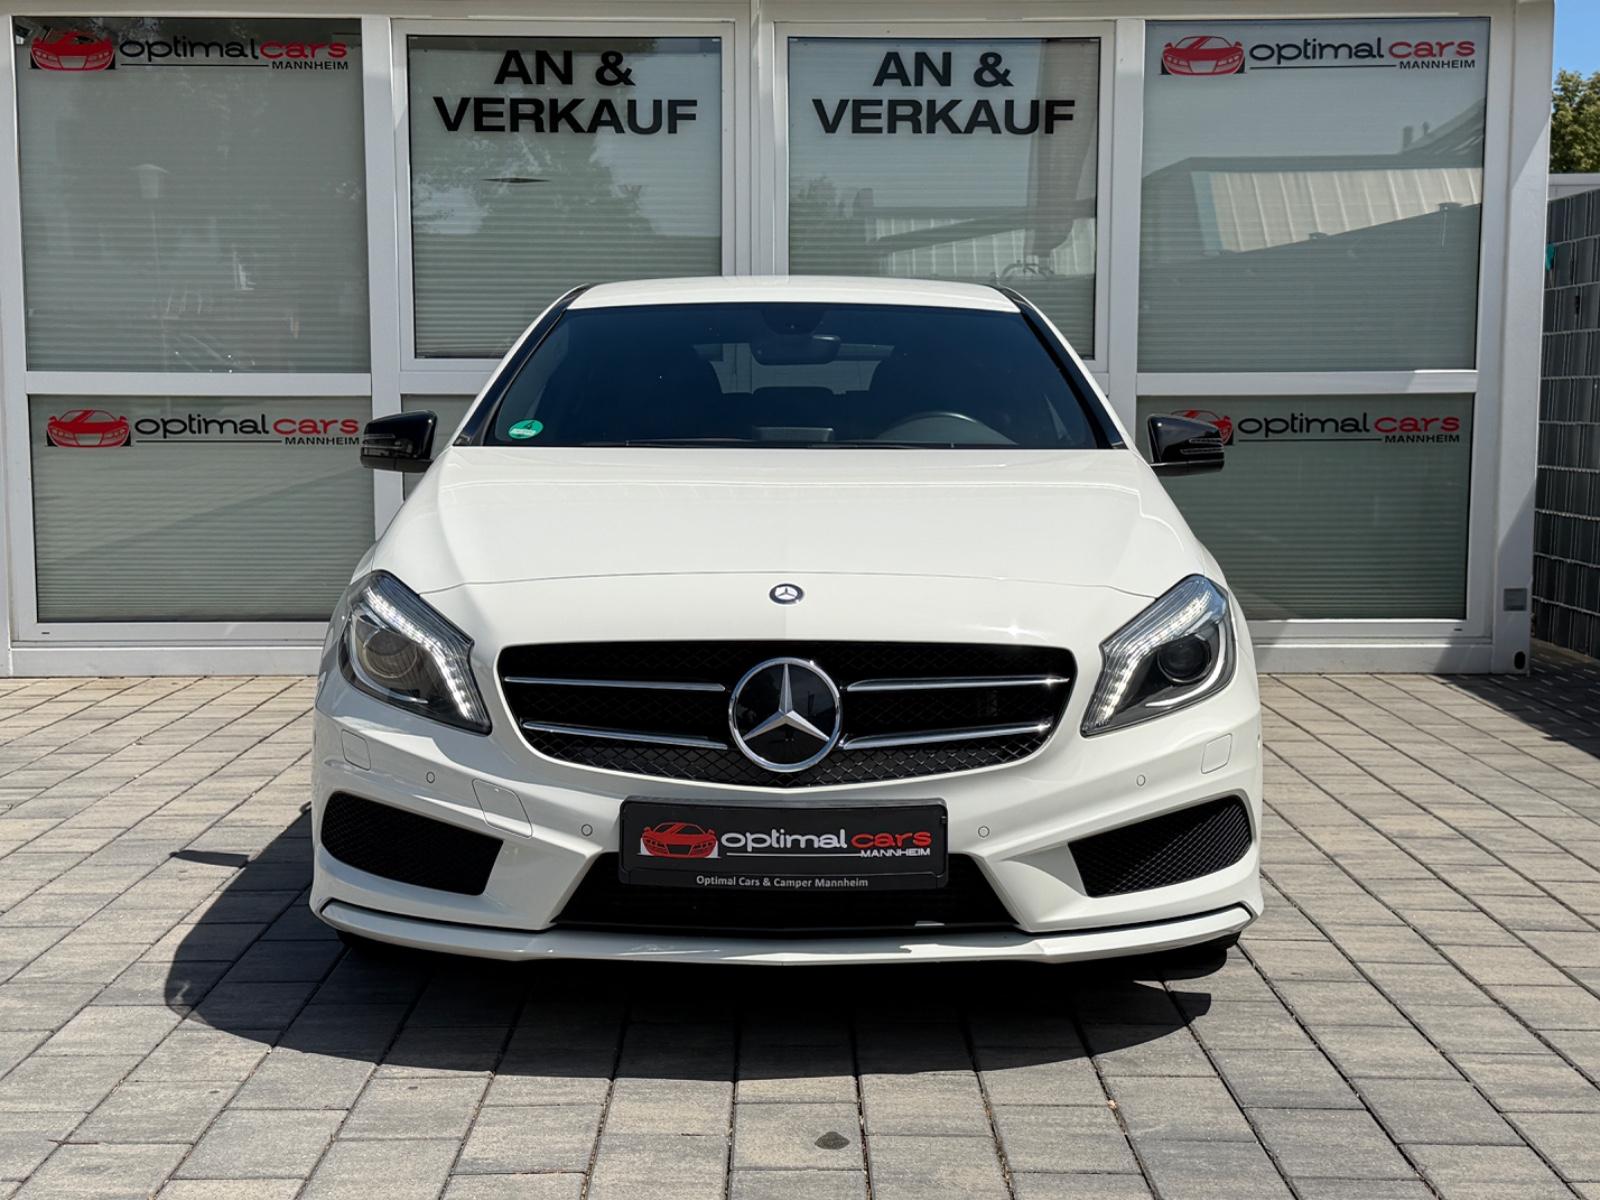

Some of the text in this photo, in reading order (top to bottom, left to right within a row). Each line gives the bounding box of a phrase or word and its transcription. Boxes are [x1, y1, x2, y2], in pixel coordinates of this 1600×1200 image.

[271, 61, 348, 70] MANNHEIM
[494, 50, 636, 86] AN &
[872, 51, 1014, 88] AN &
[1399, 59, 1475, 70] MANNHEIM
[433, 96, 698, 135] VERKAUF
[811, 98, 1075, 135] VERKAUF
[285, 437, 360, 446] MANNHEIM
[1384, 434, 1460, 444] MANNHEIM
[860, 847, 931, 858] MANNHEIM
[696, 875, 869, 888] Optimal Cars & Camper Mannheim
